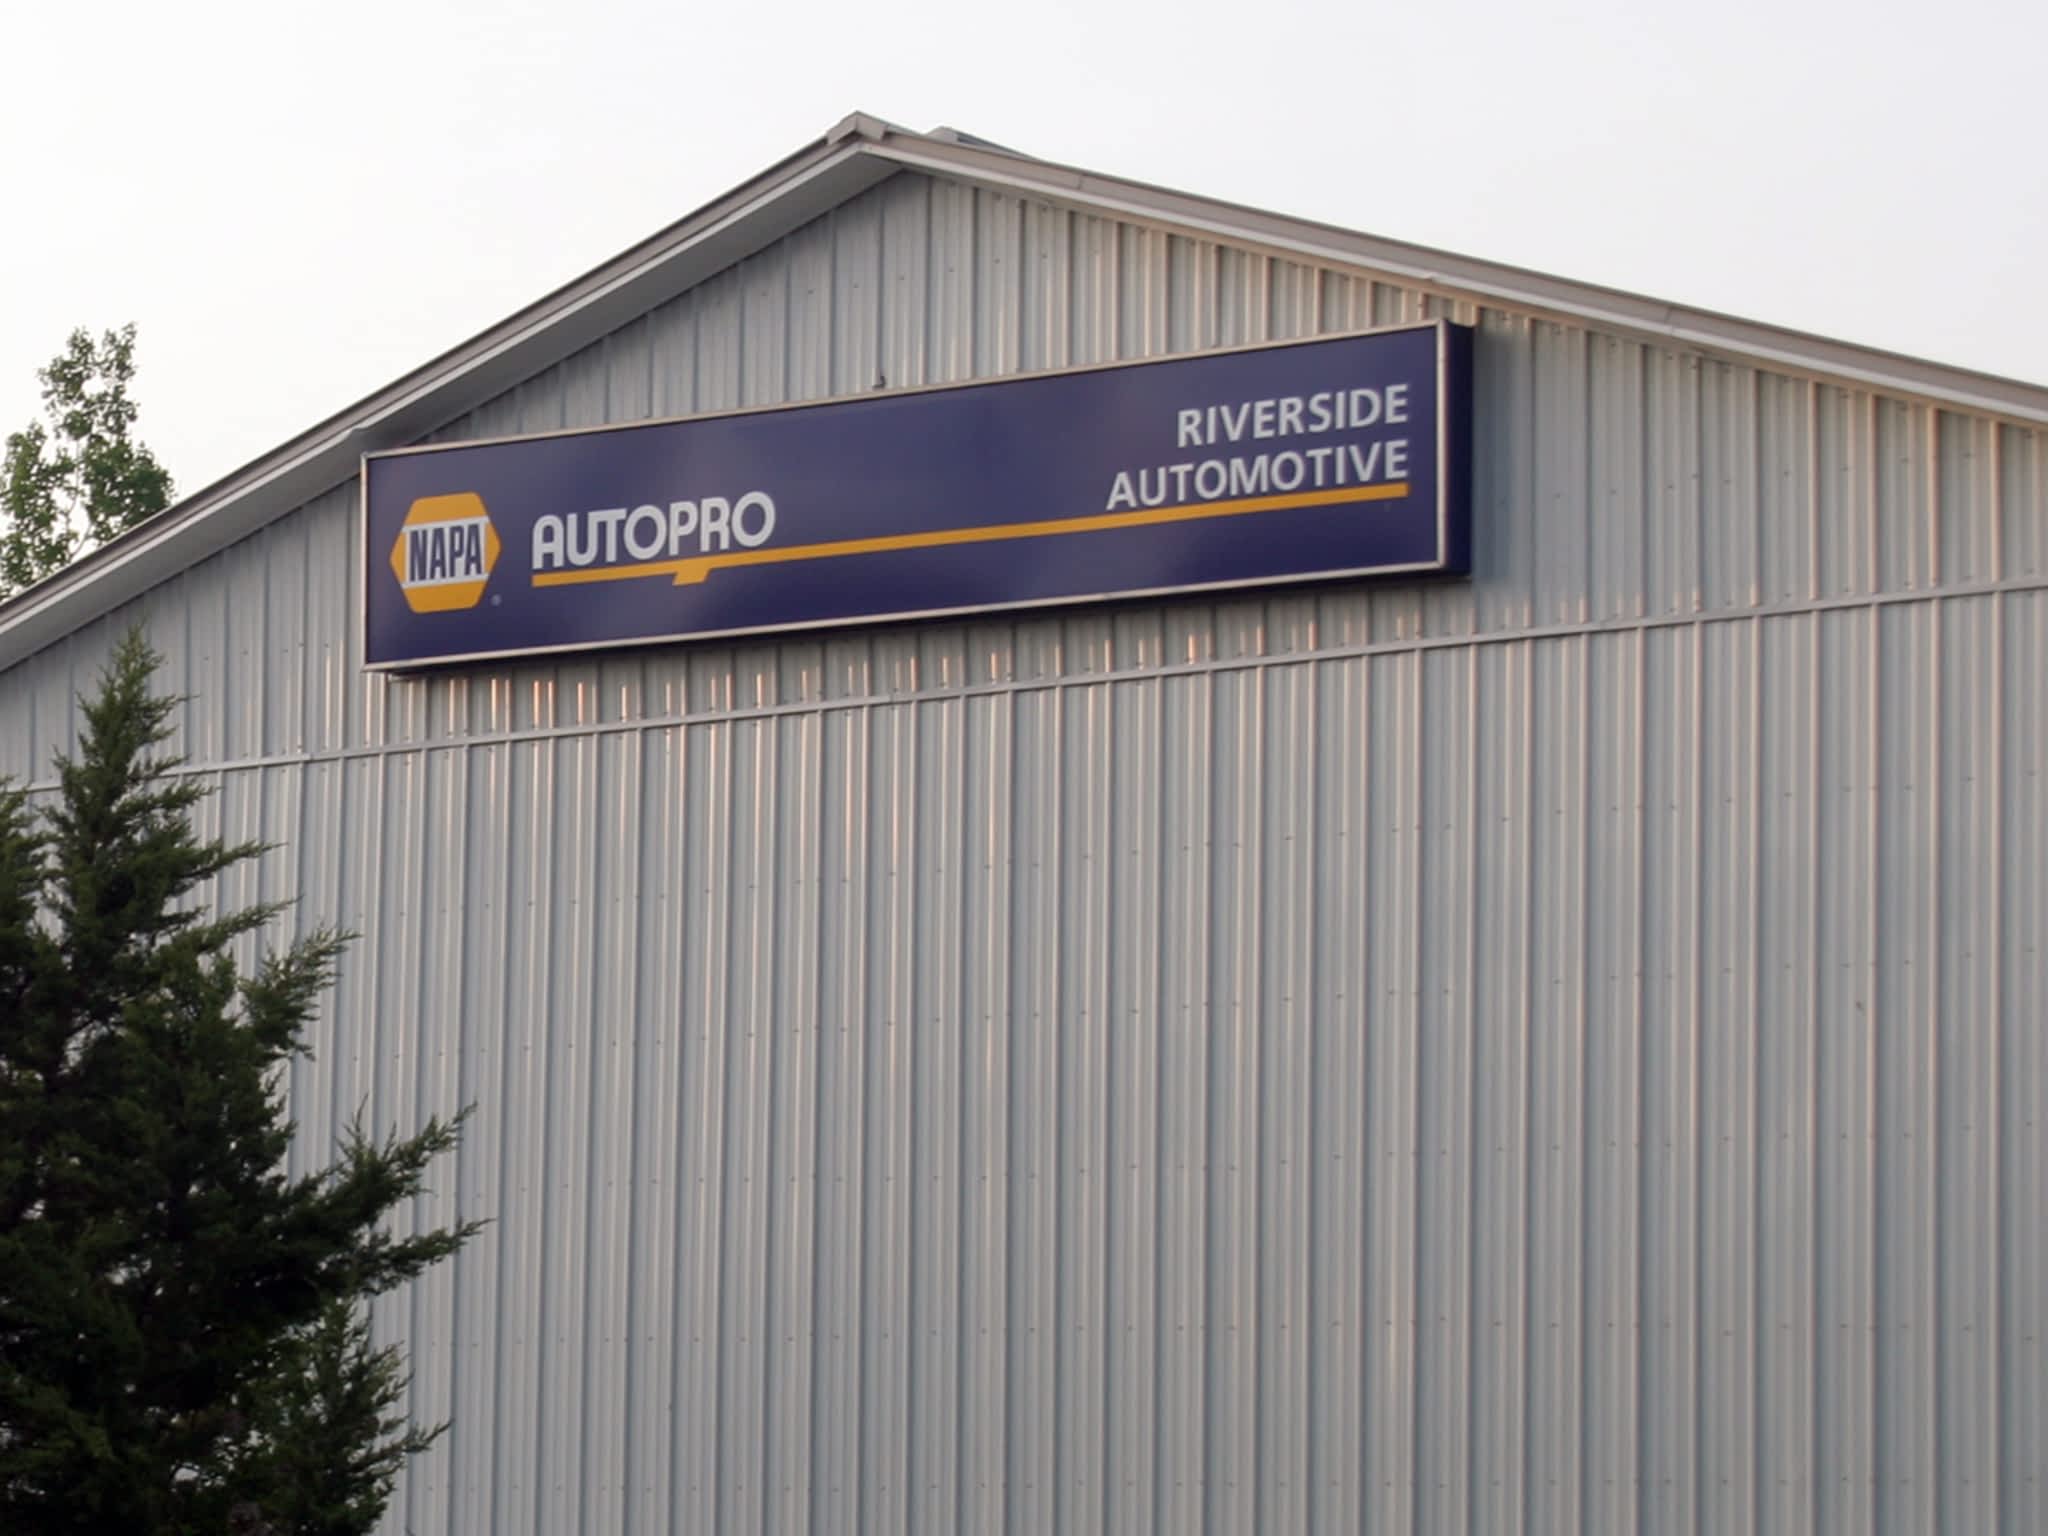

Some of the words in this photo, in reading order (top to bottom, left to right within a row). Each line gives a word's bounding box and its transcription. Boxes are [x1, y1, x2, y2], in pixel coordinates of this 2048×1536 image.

[1177, 383, 1408, 448] RIVERSIDE
[1106, 439, 1408, 511] AUTOMOTIVE
[409, 523, 483, 582] NAPA
[532, 491, 776, 570] AUTOPRO
